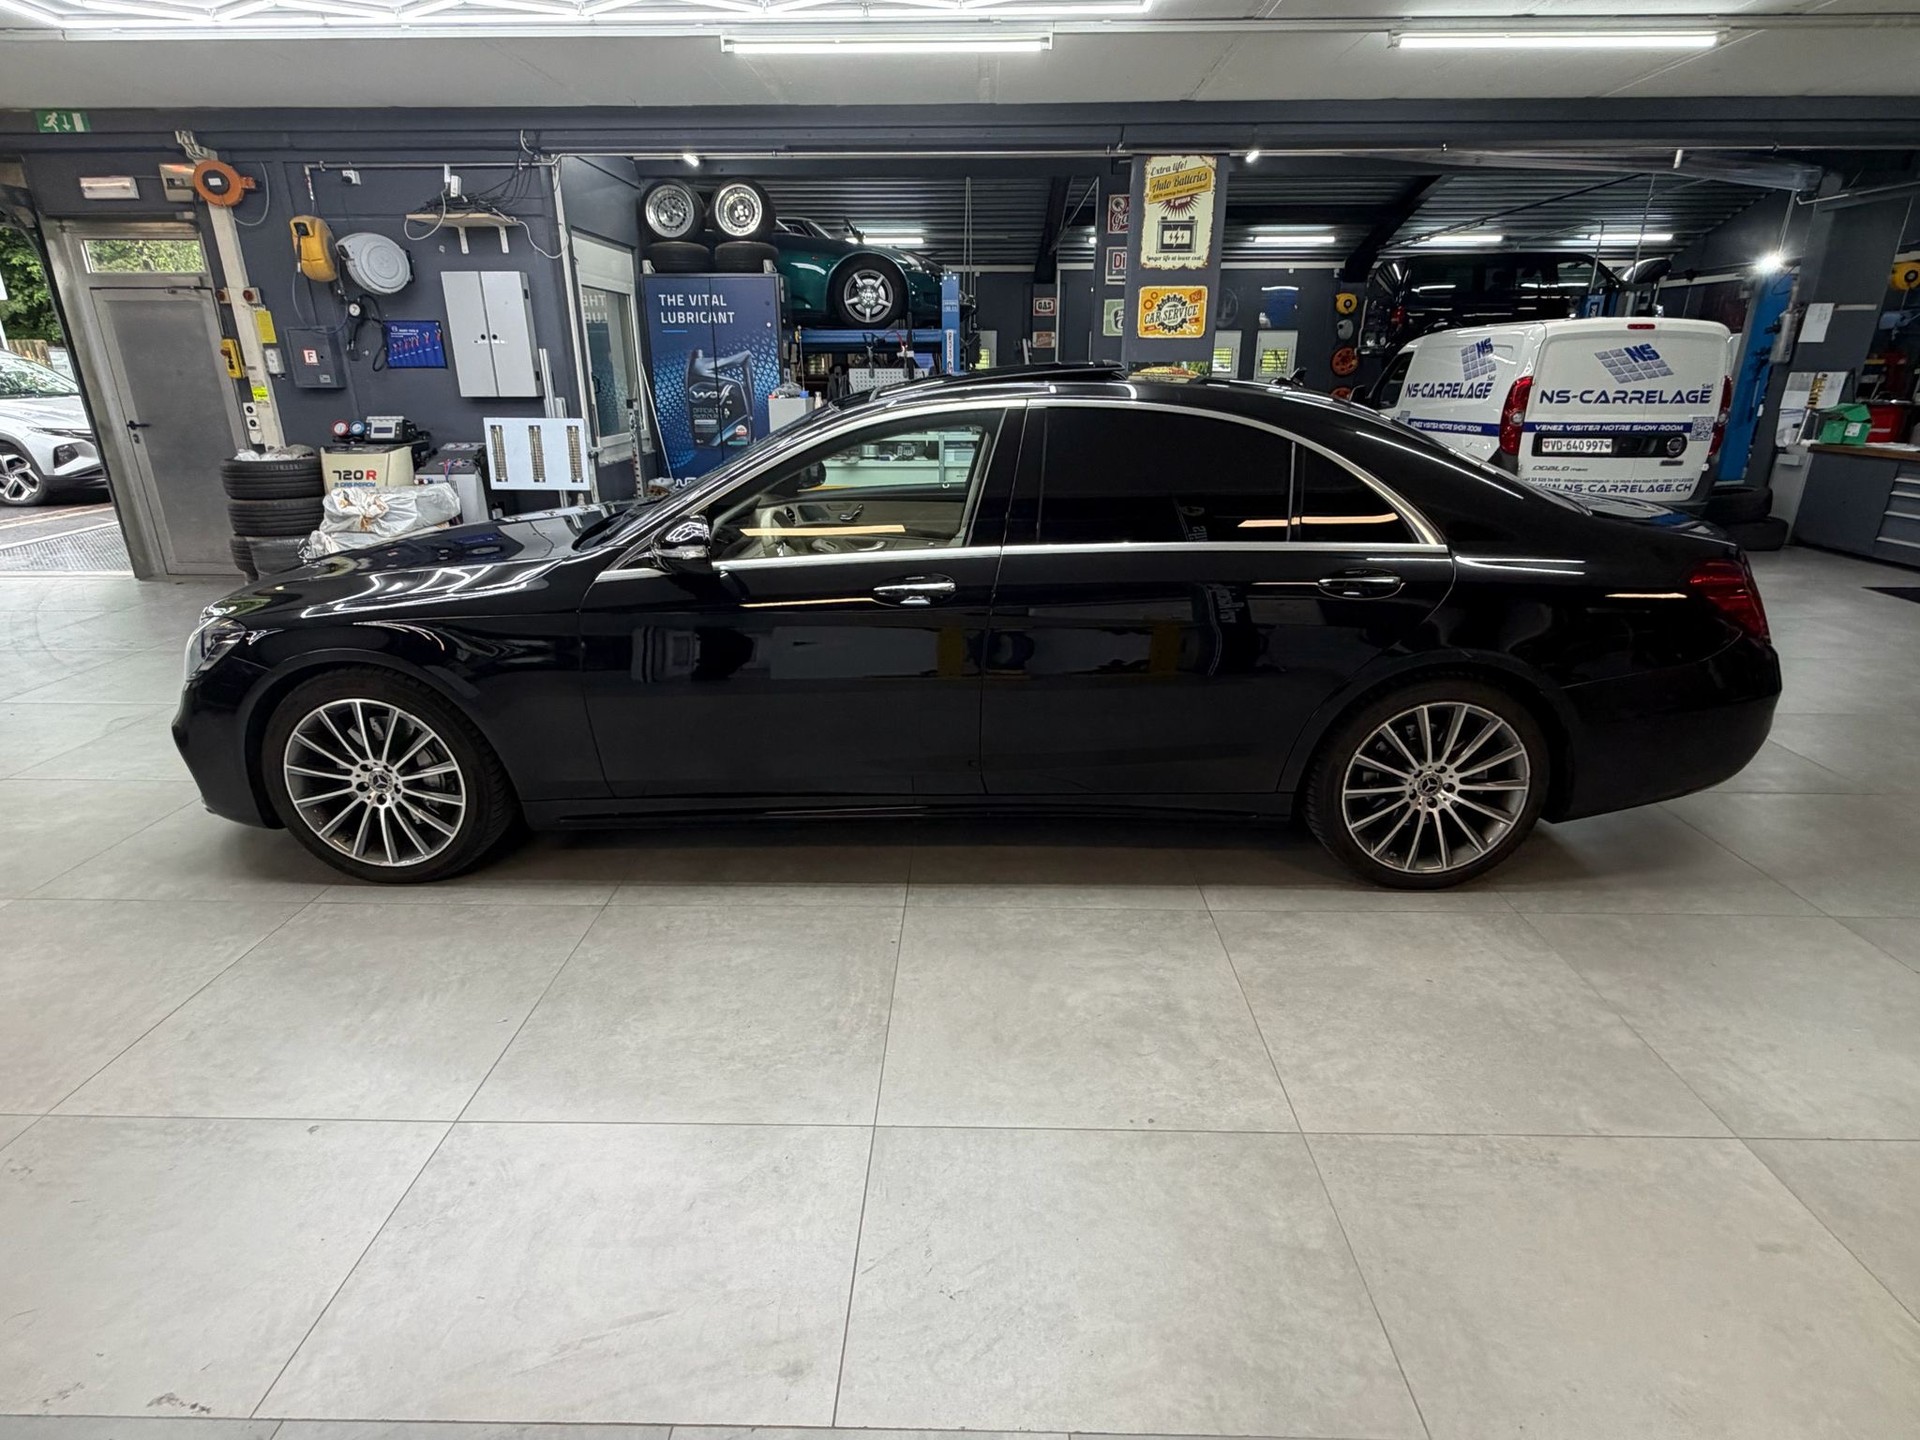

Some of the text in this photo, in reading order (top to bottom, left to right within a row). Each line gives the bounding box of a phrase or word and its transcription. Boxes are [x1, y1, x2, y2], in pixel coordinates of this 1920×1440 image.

[1151, 160, 1188, 176] Extra life!
[1152, 178, 1172, 193] Auto
[1174, 171, 1208, 188] Batteries
[658, 294, 727, 306] THE VITAL
[1037, 301, 1052, 310] GAS
[660, 311, 735, 324] LUBRICANT
[1144, 311, 1161, 324] CAR
[1163, 305, 1198, 321] SERVICE
[1476, 337, 1494, 358] NS
[1624, 343, 1660, 363] NS
[307, 350, 314, 362] F
[1405, 382, 1494, 399] NS-CARRELAGE
[1539, 390, 1712, 404] NS-CARRELAGE
